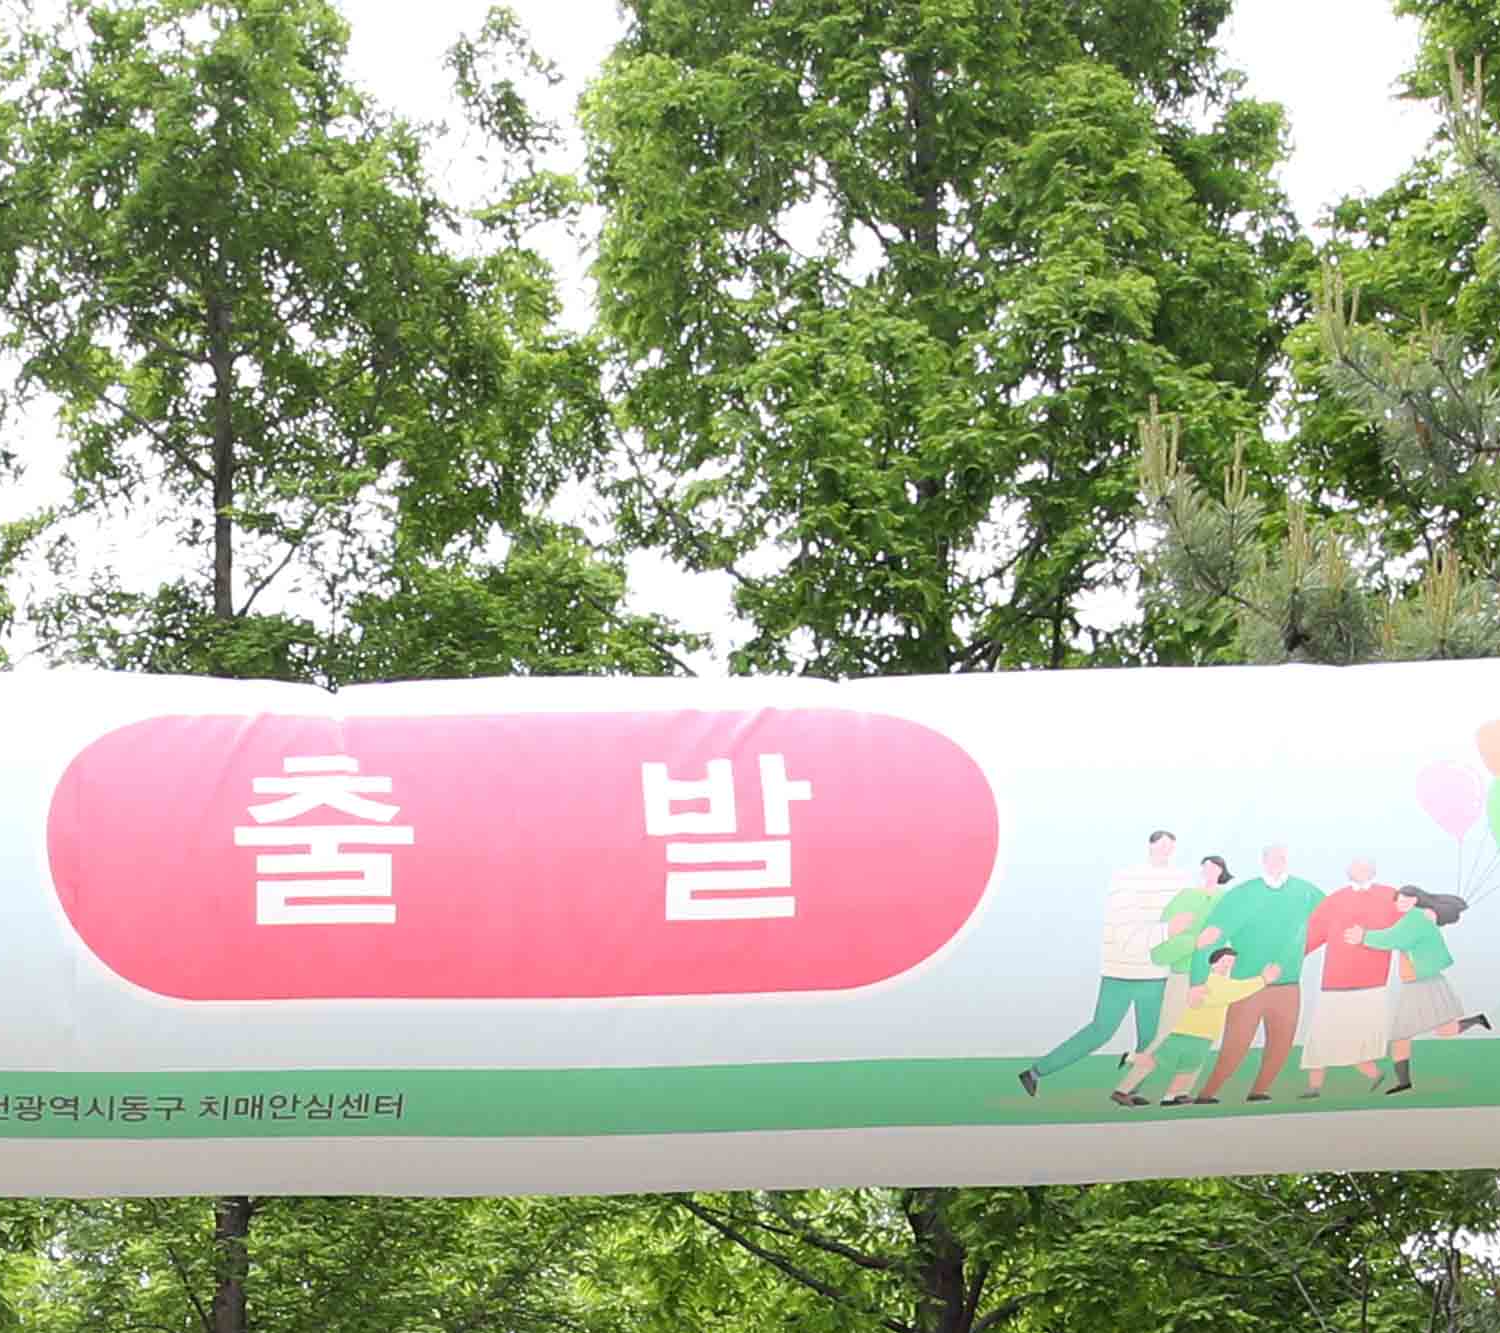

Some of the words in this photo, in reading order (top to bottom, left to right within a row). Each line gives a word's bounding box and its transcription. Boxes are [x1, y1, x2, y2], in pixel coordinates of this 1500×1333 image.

[233, 754, 415, 926] 출
[640, 752, 812, 922] 발
[198, 1090, 405, 1122] 치매안심센터
